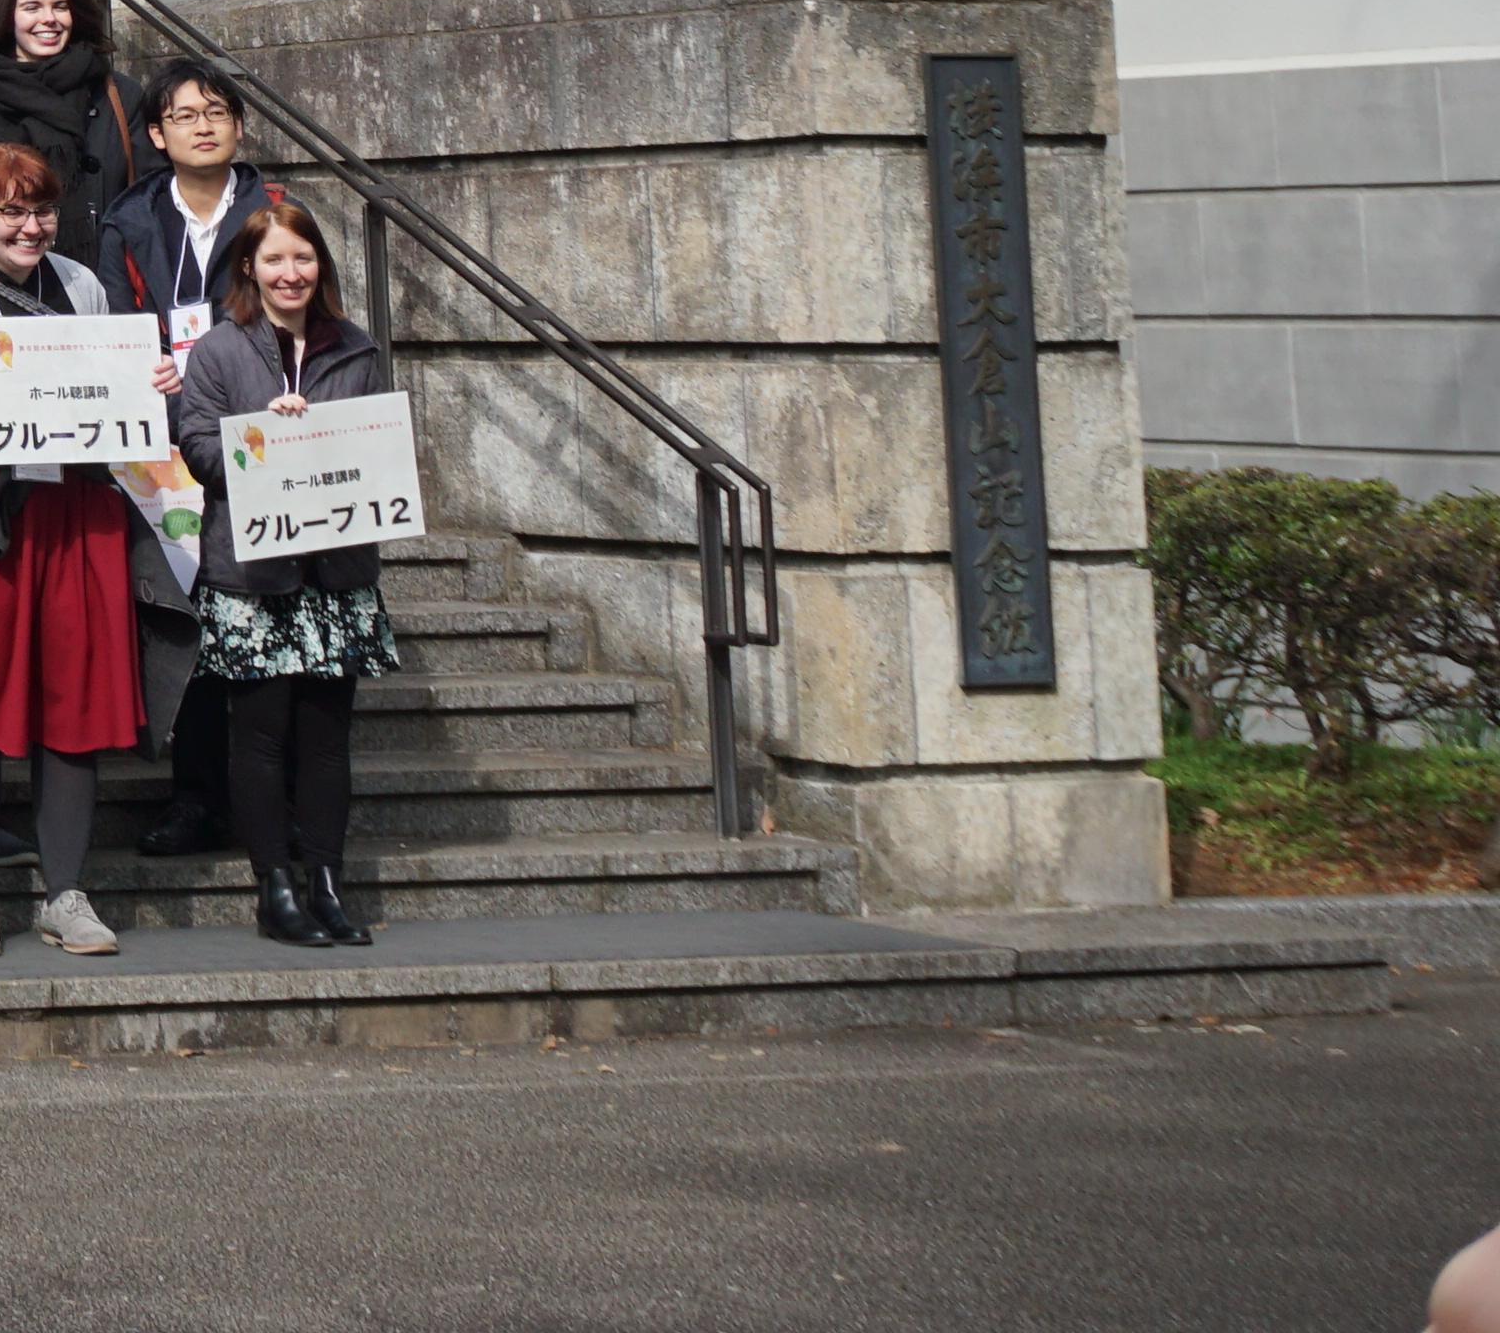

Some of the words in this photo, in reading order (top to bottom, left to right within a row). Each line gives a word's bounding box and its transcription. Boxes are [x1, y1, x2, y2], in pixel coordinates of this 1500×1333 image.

[945, 77, 1038, 660] 横浜市大倉山記念館
[30, 385, 109, 400] ホール聴講時
[282, 468, 360, 492] ホール聴講時
